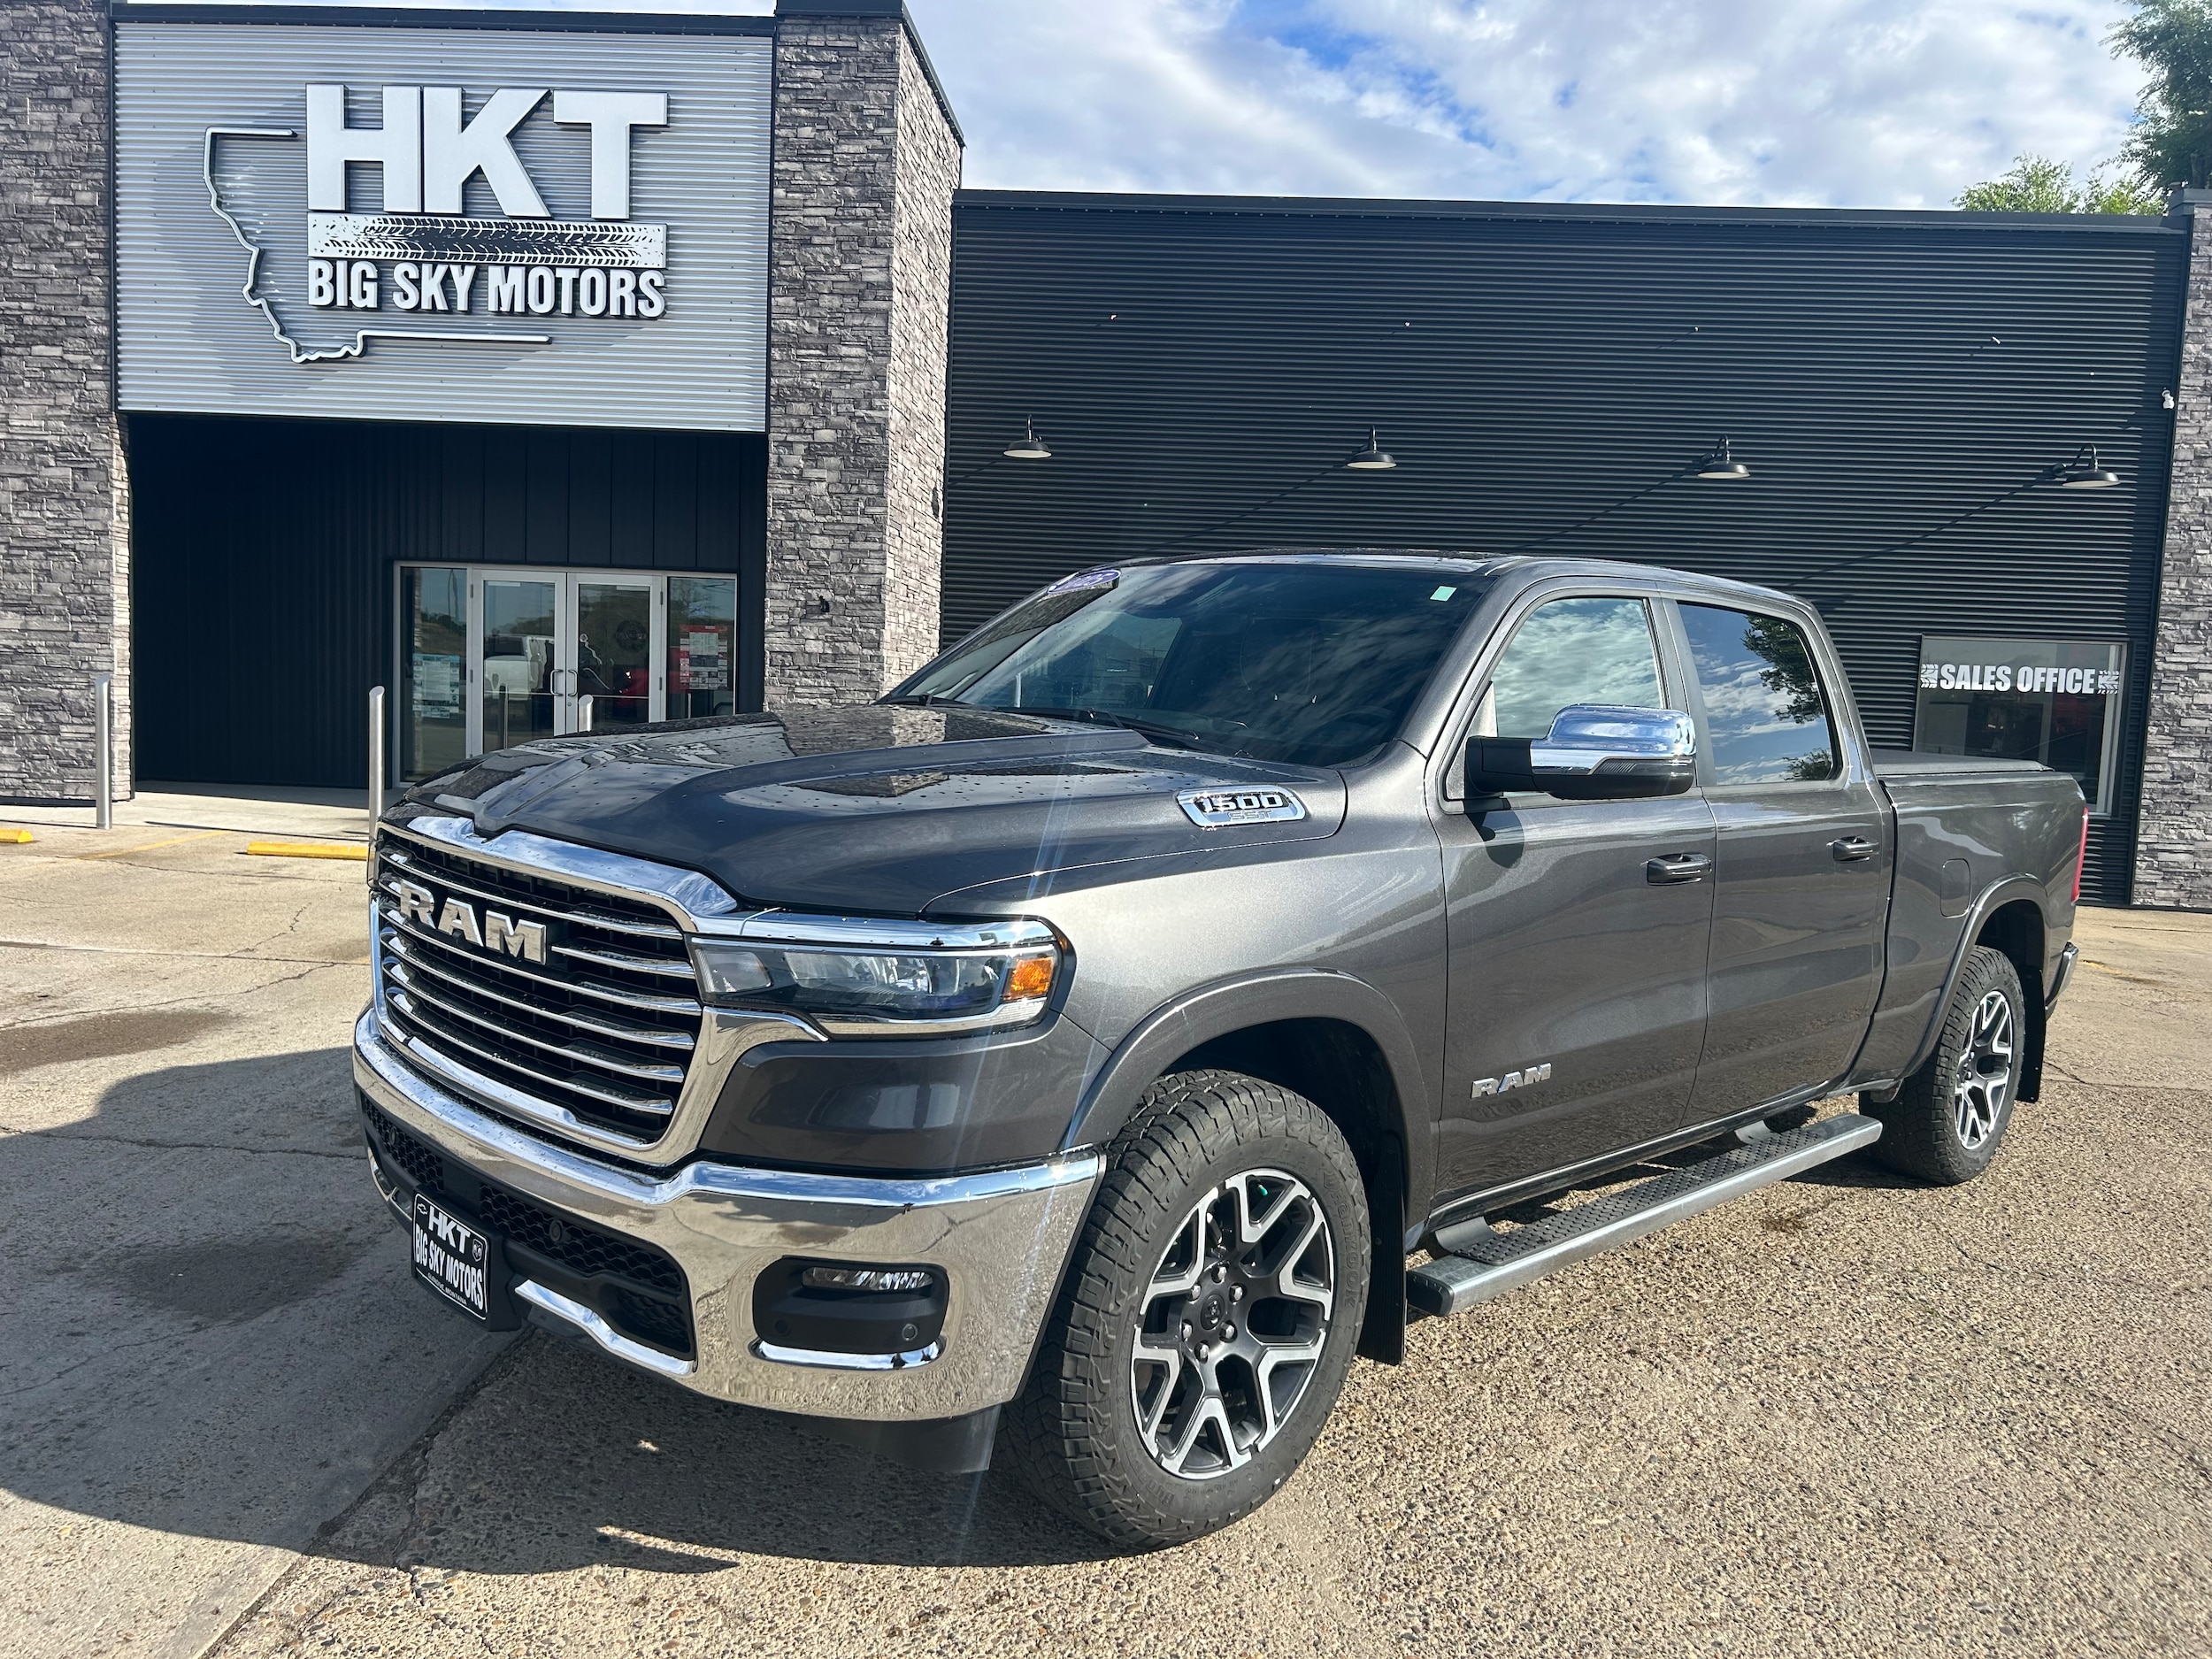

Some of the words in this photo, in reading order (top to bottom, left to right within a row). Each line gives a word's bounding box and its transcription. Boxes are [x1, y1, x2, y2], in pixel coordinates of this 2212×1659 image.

[306, 83, 668, 219] HKT
[307, 259, 379, 308] BIG
[393, 262, 476, 311] SKY
[488, 265, 666, 318] MOTORS
[1939, 664, 2012, 692] SALES
[2016, 666, 2096, 695] OFFICE
[1201, 794, 1284, 813] 1500
[399, 879, 547, 965] RAM
[1471, 1062, 1552, 1098] RAM
[428, 1205, 471, 1254] HKT
[416, 1223, 428, 1267] BIG
[429, 1240, 445, 1277] SKY
[446, 1255, 483, 1310] MOTORS
